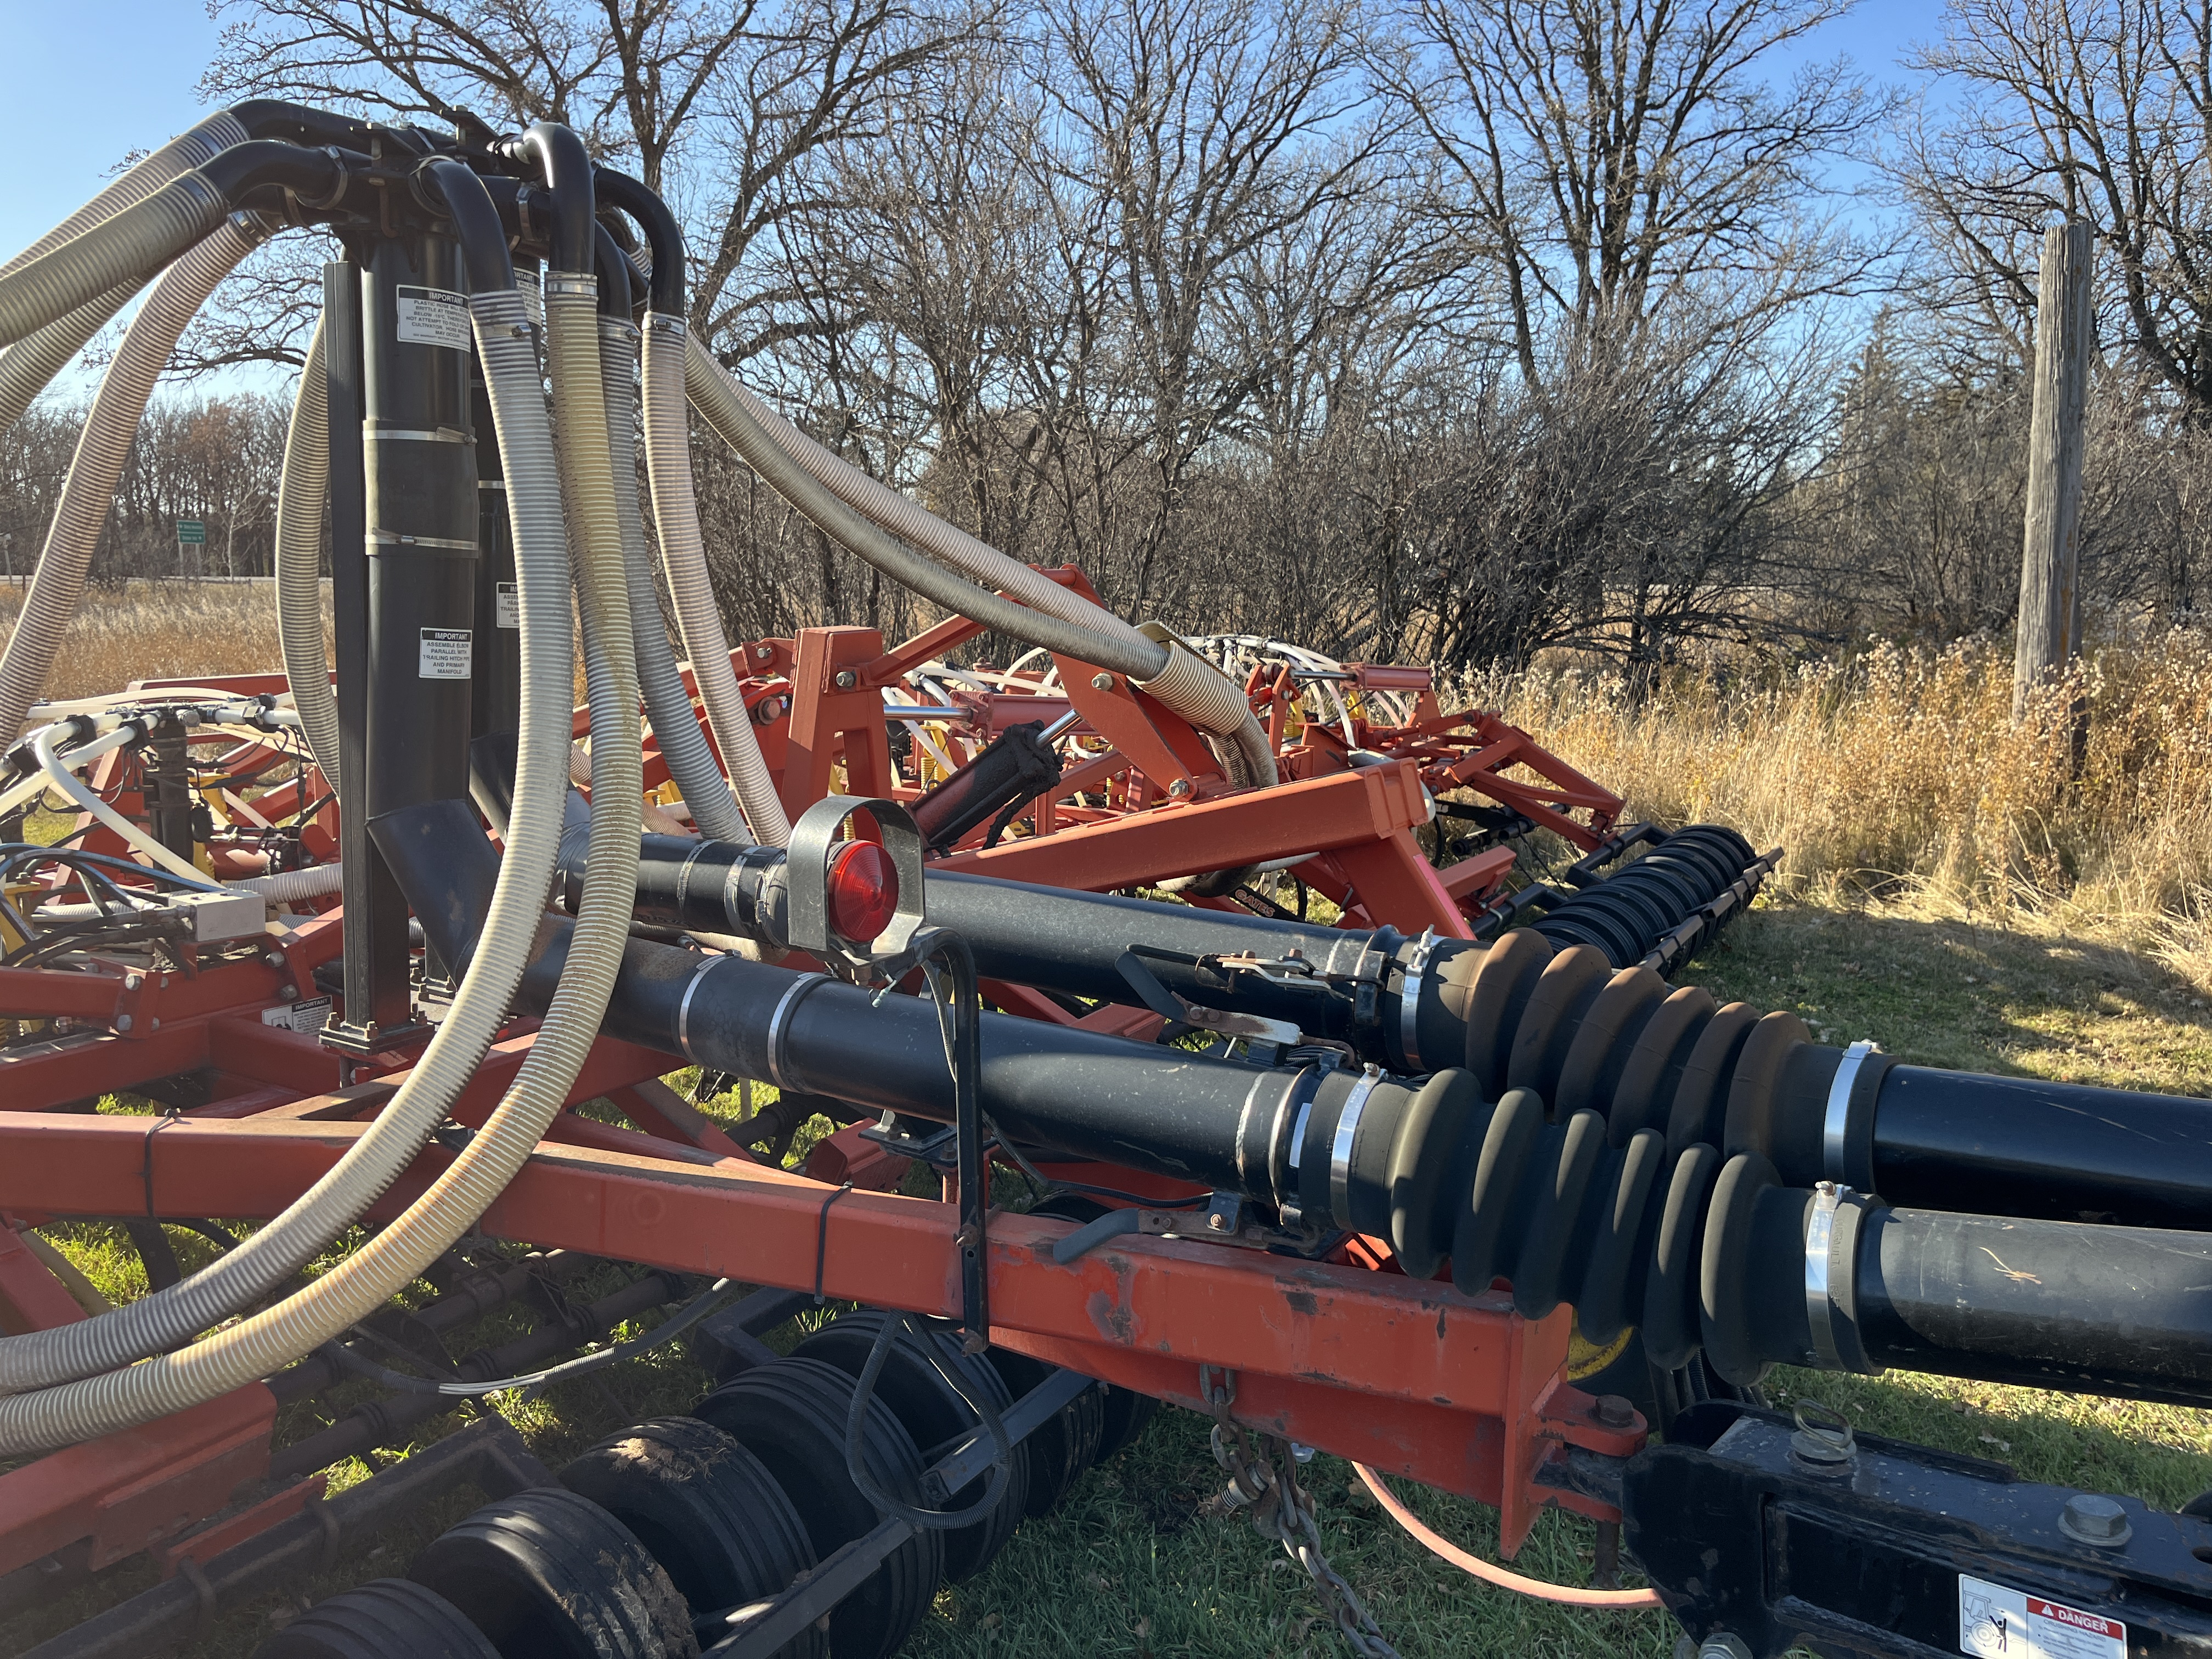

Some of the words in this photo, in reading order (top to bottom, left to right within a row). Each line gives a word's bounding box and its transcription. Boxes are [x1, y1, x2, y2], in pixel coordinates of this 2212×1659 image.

[429, 292, 463, 304] IMPORTANT
[435, 632, 468, 641] IMPORTANT
[1235, 889, 1276, 917] GATES
[295, 998, 328, 1010] IMPORTANT
[2058, 1609, 2109, 1634] DANGER
[2044, 1619, 2078, 1634] CRUSHING
[2079, 1630, 2107, 1643] HAZARD
